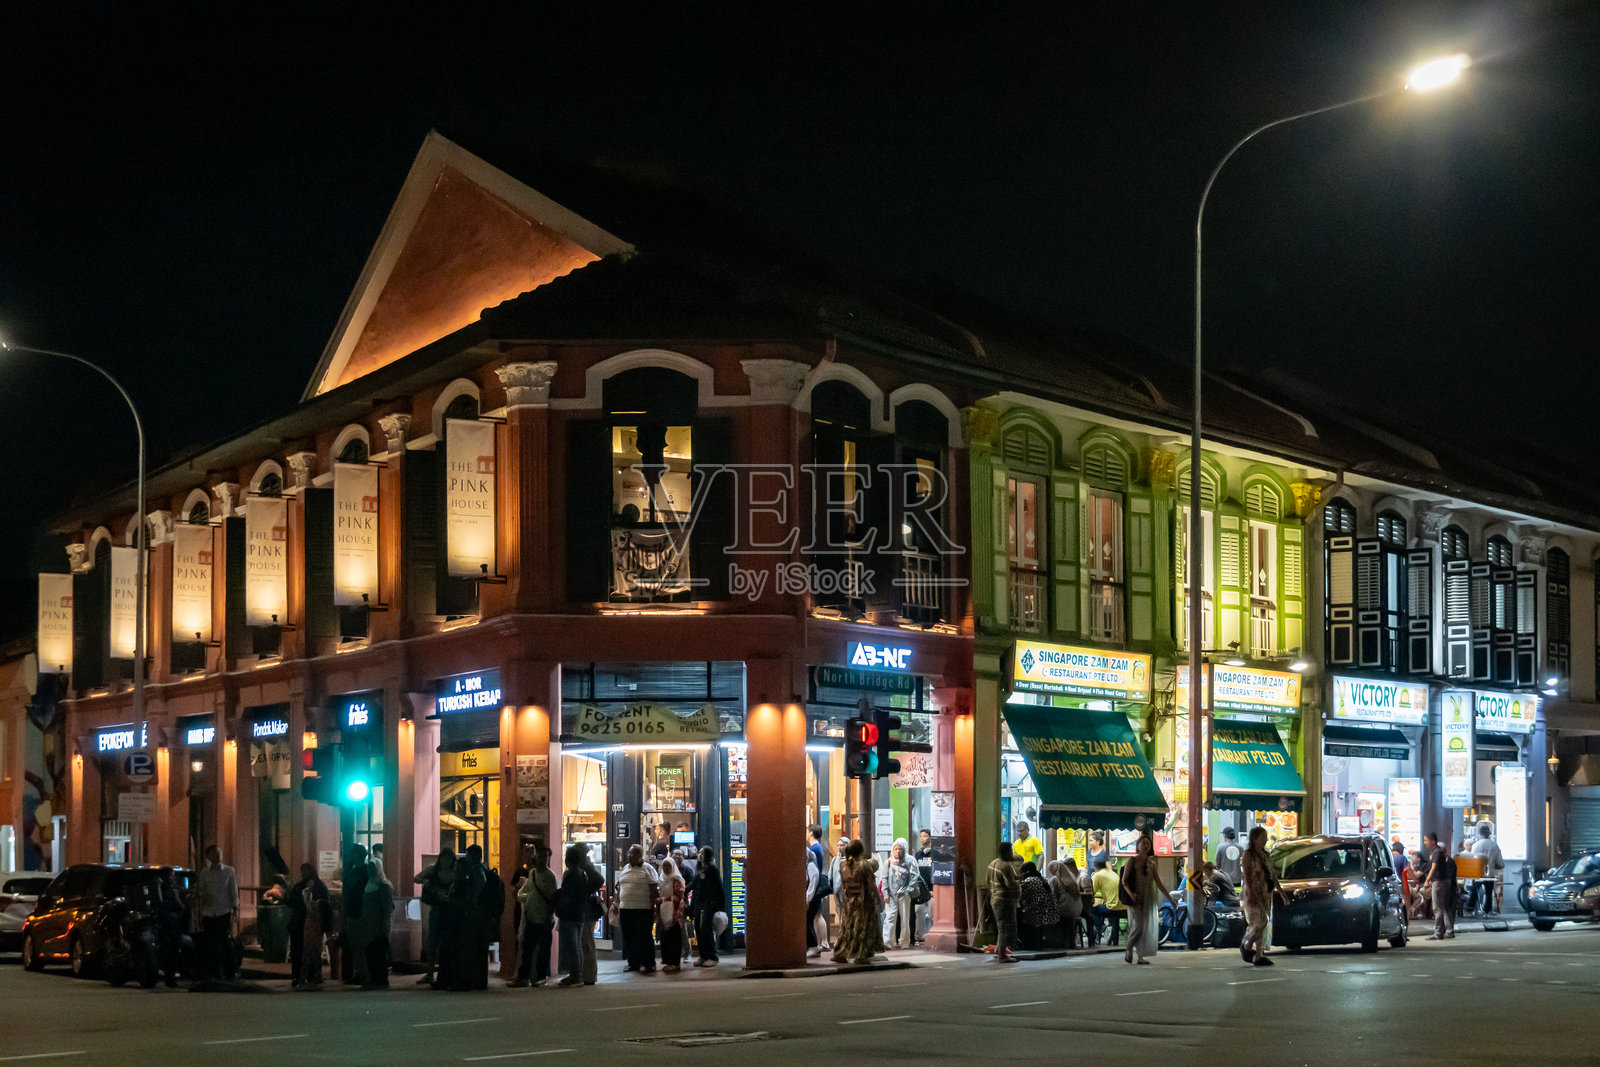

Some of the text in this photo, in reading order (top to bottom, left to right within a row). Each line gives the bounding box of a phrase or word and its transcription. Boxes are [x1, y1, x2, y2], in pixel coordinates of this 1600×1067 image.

[451, 461, 472, 473] THE
[450, 477, 489, 493] PINK
[338, 501, 359, 511] THE
[451, 497, 489, 510] HOUSE
[338, 516, 373, 530] PINK
[249, 530, 269, 540] THE
[338, 534, 373, 545] HOUSE
[249, 544, 282, 557] PINK
[177, 555, 195, 563] THE
[249, 561, 282, 571] HOUSE
[177, 567, 208, 580] PINK
[114, 576, 131, 585] THE
[114, 588, 135, 599] PIN
[176, 584, 208, 592] HOUSE
[42, 600, 60, 608] THE
[41, 610, 69, 620] PINK
[1038, 650, 1129, 671] SINGAPORE ZAM ZAM
[823, 668, 911, 690] North Bridge Rd
[1049, 667, 1119, 683] RESTAURANT PTE LTD
[1214, 671, 1251, 685] INGAPORE
[1252, 675, 1268, 686] ZAM
[1268, 677, 1284, 688] ZAM
[1219, 687, 1253, 697] RESTAURANT
[1254, 689, 1264, 698] PTE
[1350, 683, 1398, 708] VICTORY
[438, 693, 473, 712] TURKISH
[1476, 695, 1510, 718] ICTORY
[581, 721, 665, 735] 9625 0165
[1022, 736, 1137, 758] SINGAPORE ZAM ZAM
[1213, 748, 1286, 766] TAURANT PTE LTD
[130, 754, 154, 776] P
[1033, 760, 1145, 779] RESTAURANT PTE LTD
[612, 803, 624, 817] open
[1077, 816, 1089, 825] Gas
